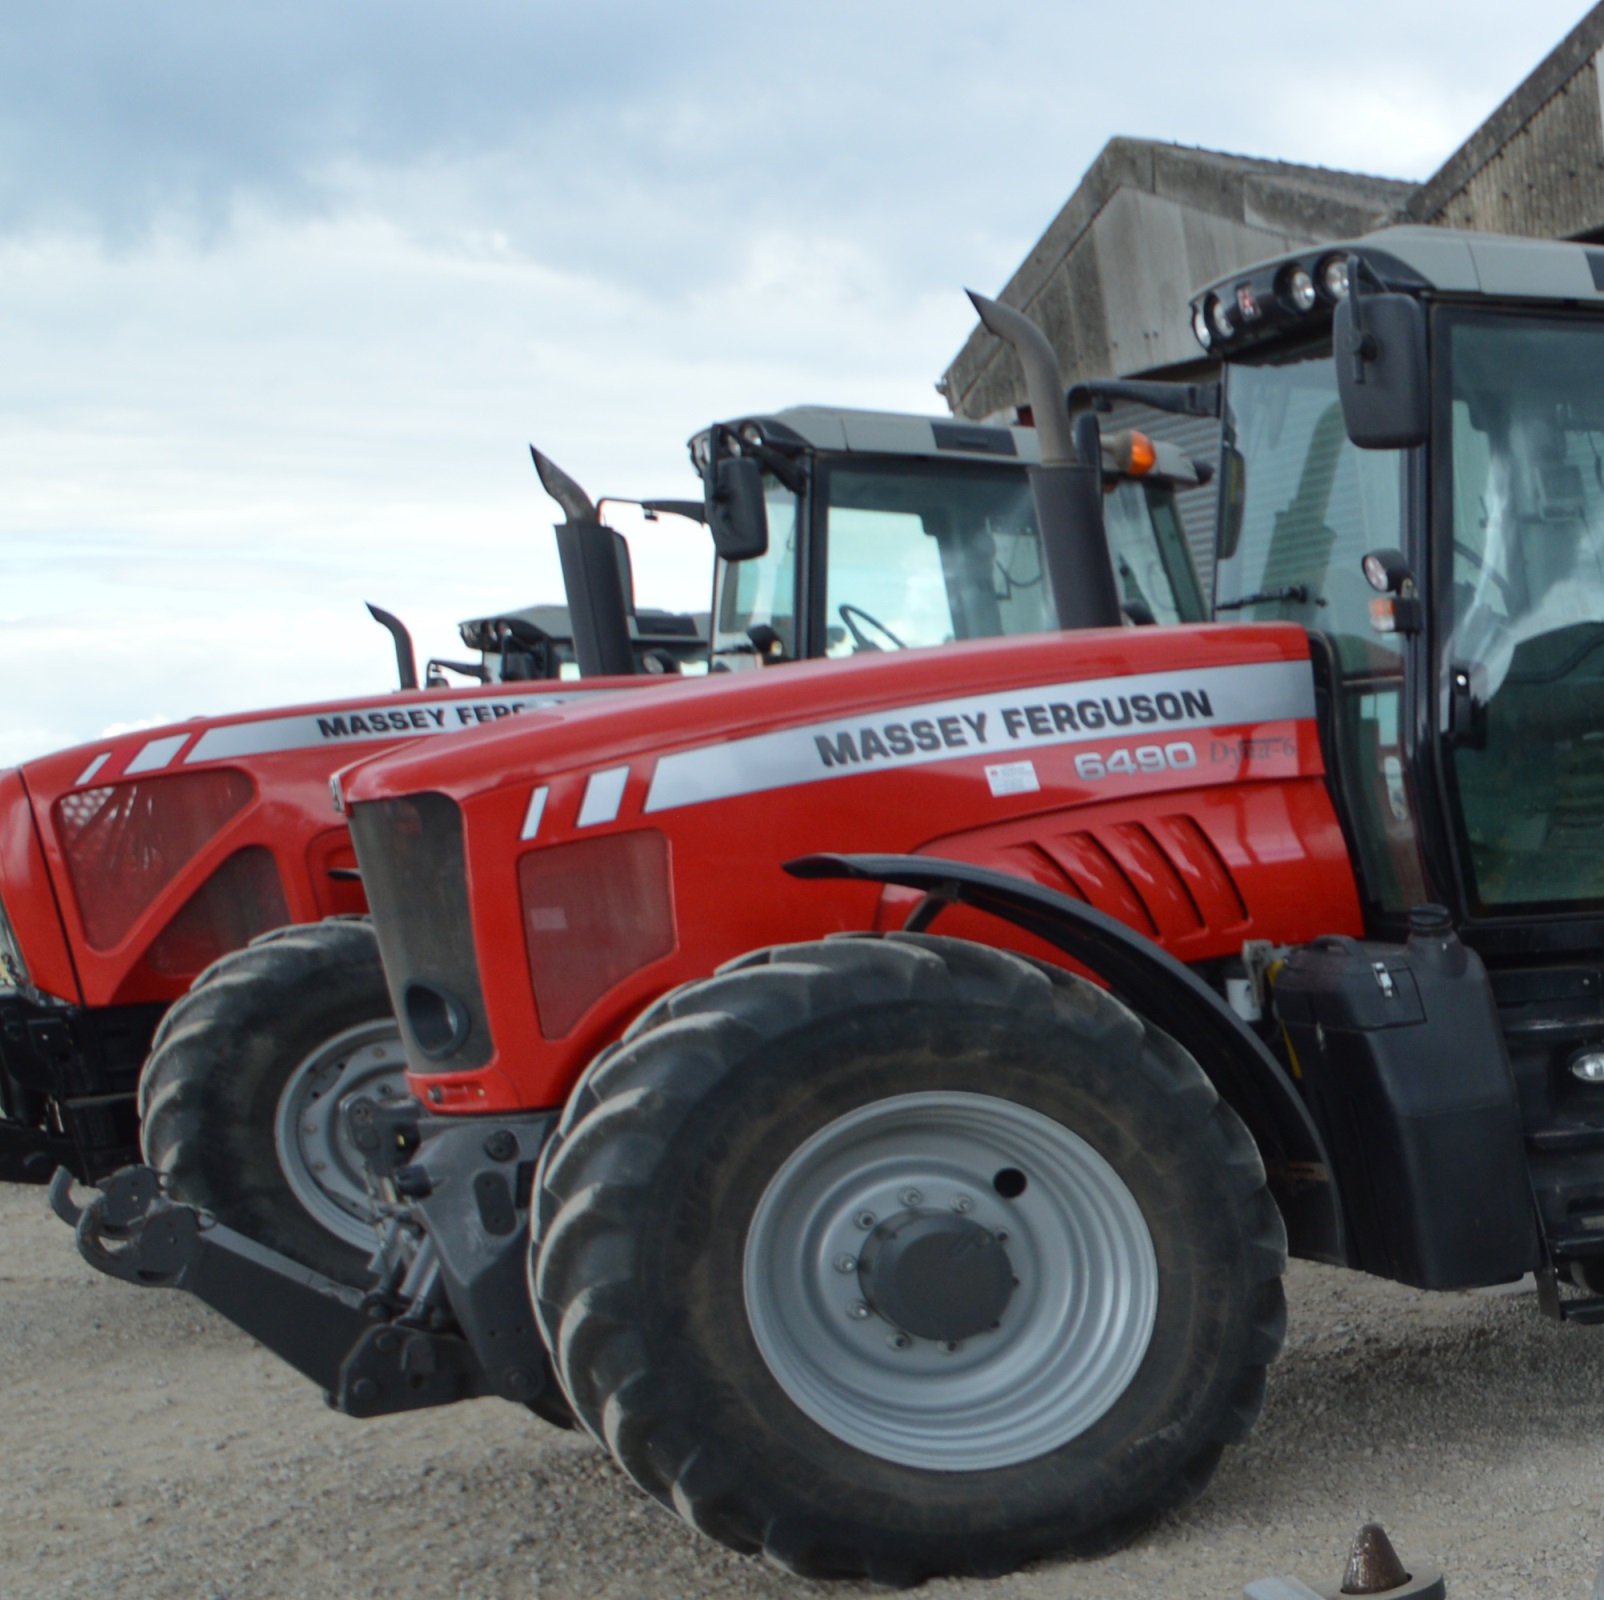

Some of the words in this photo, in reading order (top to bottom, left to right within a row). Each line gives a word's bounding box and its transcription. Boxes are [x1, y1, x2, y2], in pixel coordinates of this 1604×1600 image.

[317, 708, 445, 739] MASSEY
[814, 713, 988, 767] MASSEY
[1001, 689, 1214, 739] FERGUSON
[1074, 741, 1198, 781] 6490
[1210, 737, 1297, 769] Dyna-6
